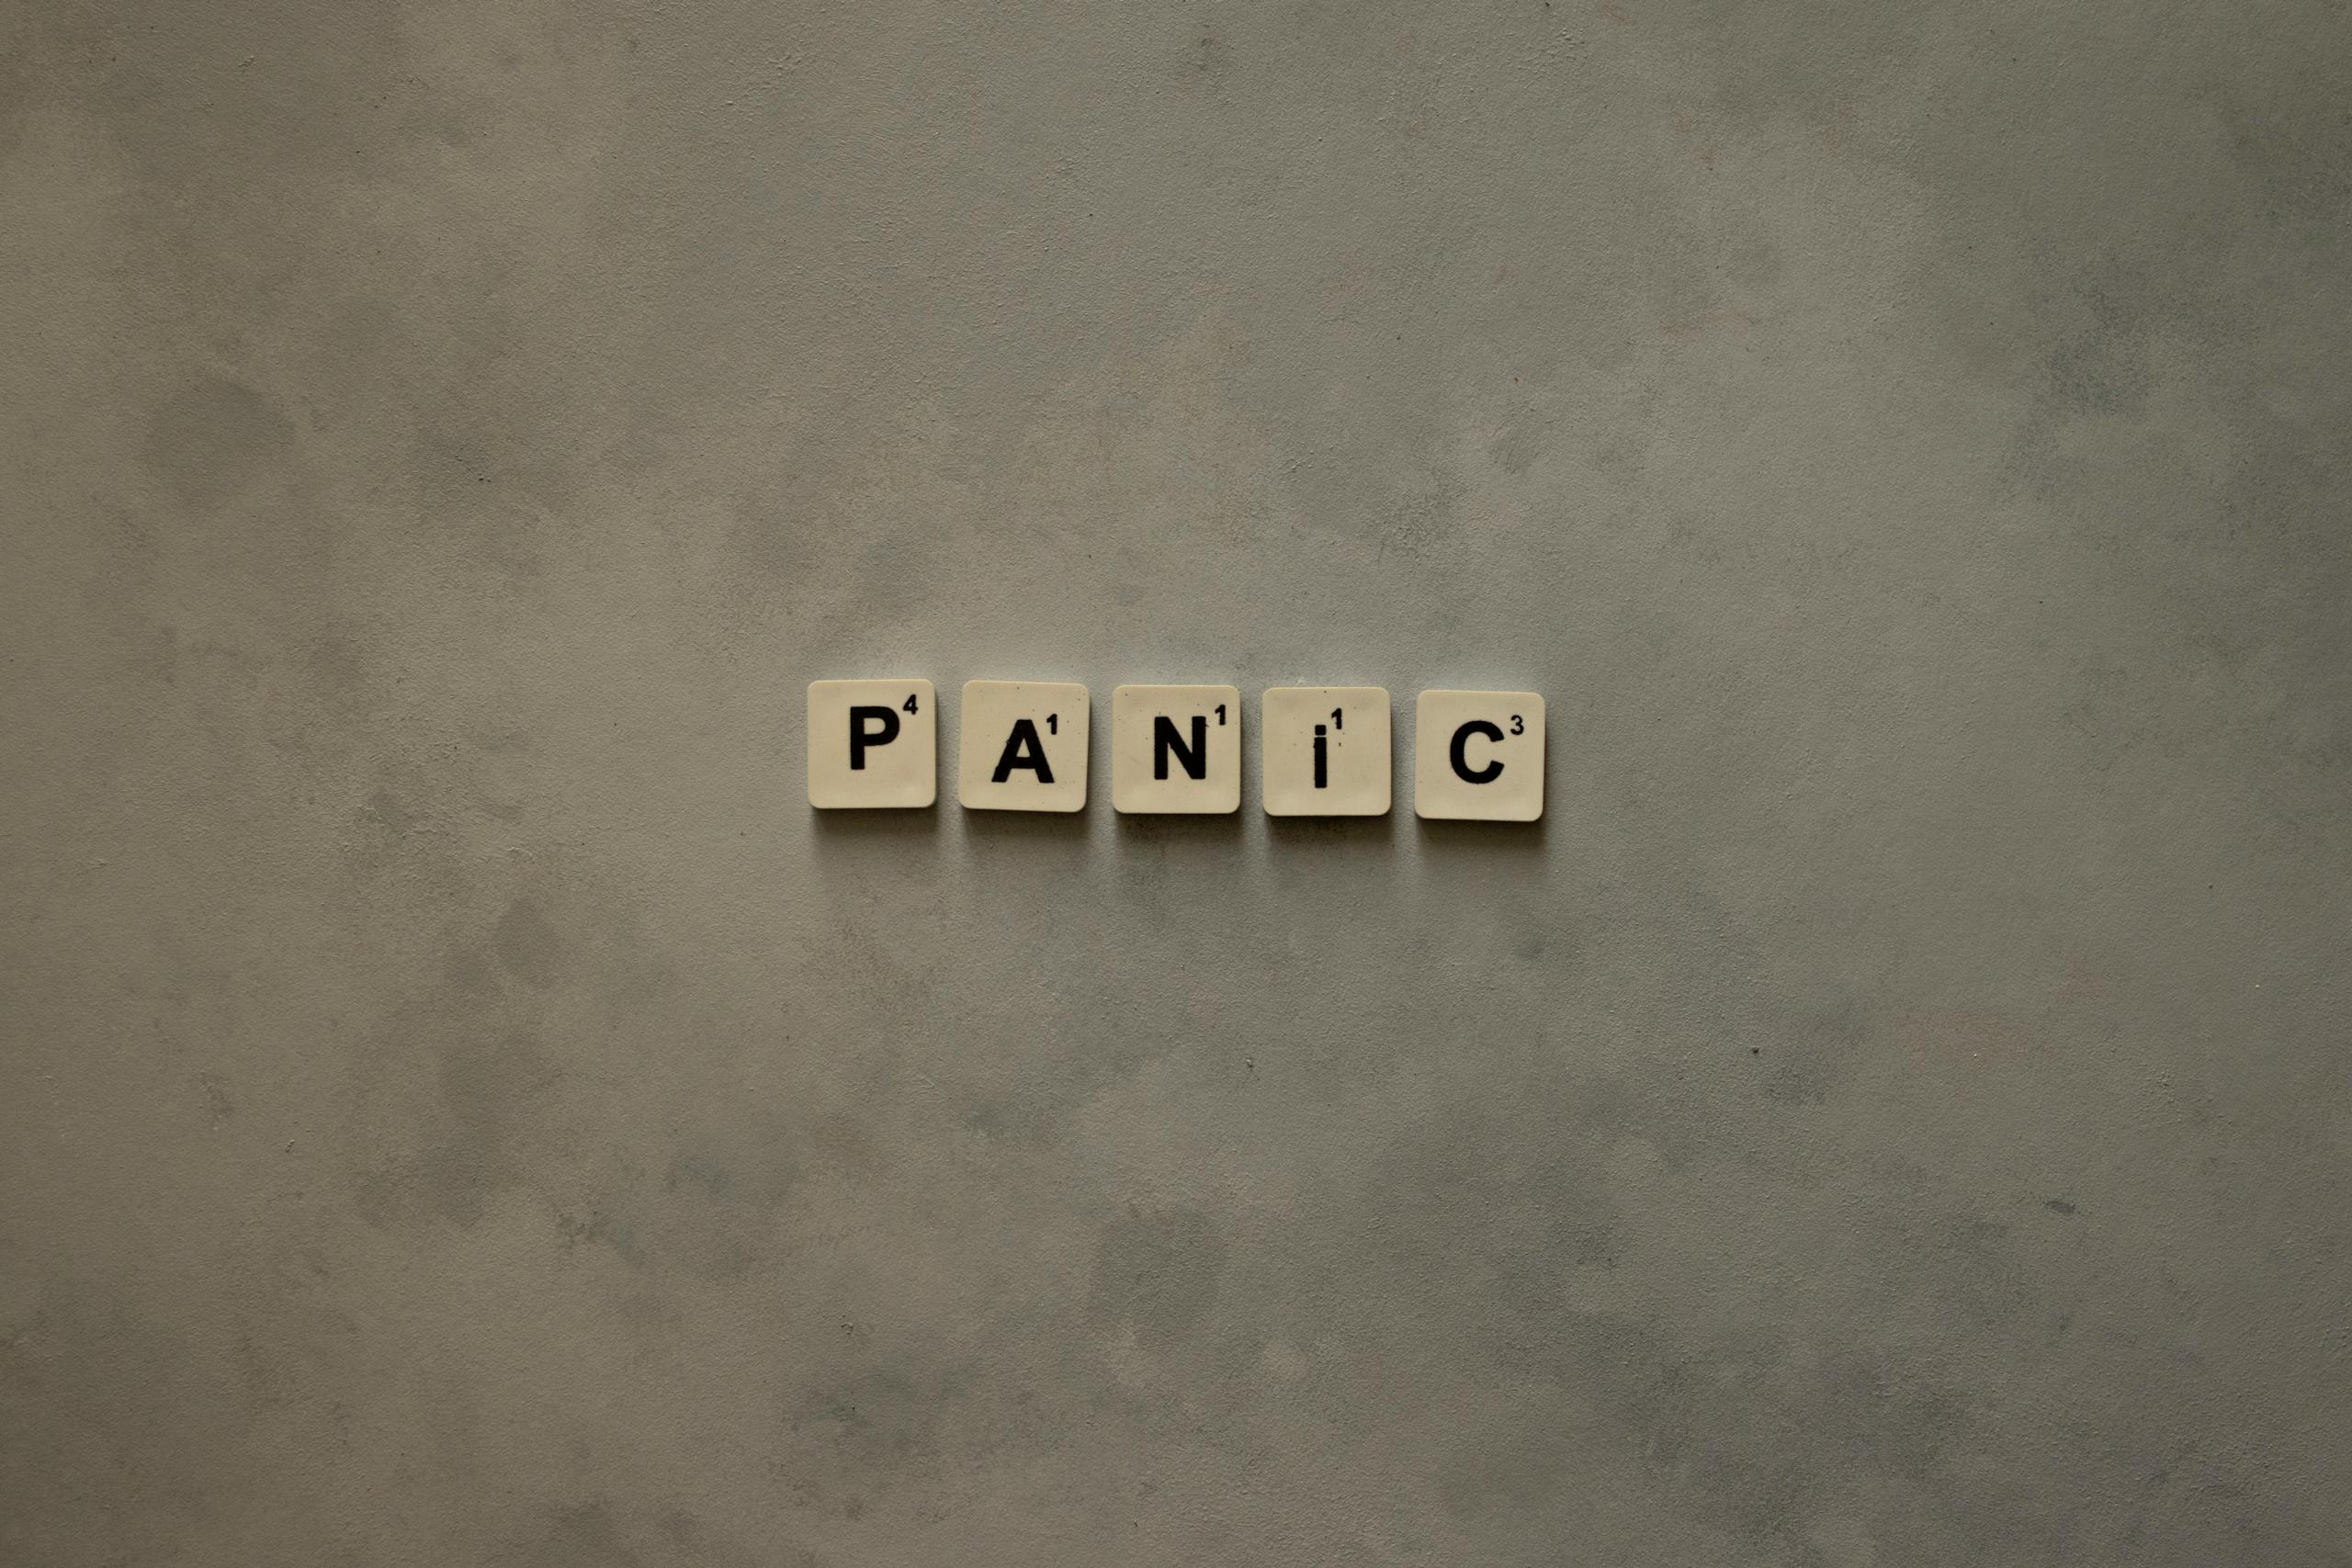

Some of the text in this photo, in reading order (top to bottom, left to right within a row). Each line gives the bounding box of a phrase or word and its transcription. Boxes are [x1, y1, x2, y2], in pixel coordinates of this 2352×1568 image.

[902, 694, 919, 716] 4
[1214, 704, 1227, 727] 1
[1046, 713, 1058, 736] 1
[1330, 707, 1342, 730] 1
[1510, 714, 1525, 736] 3
